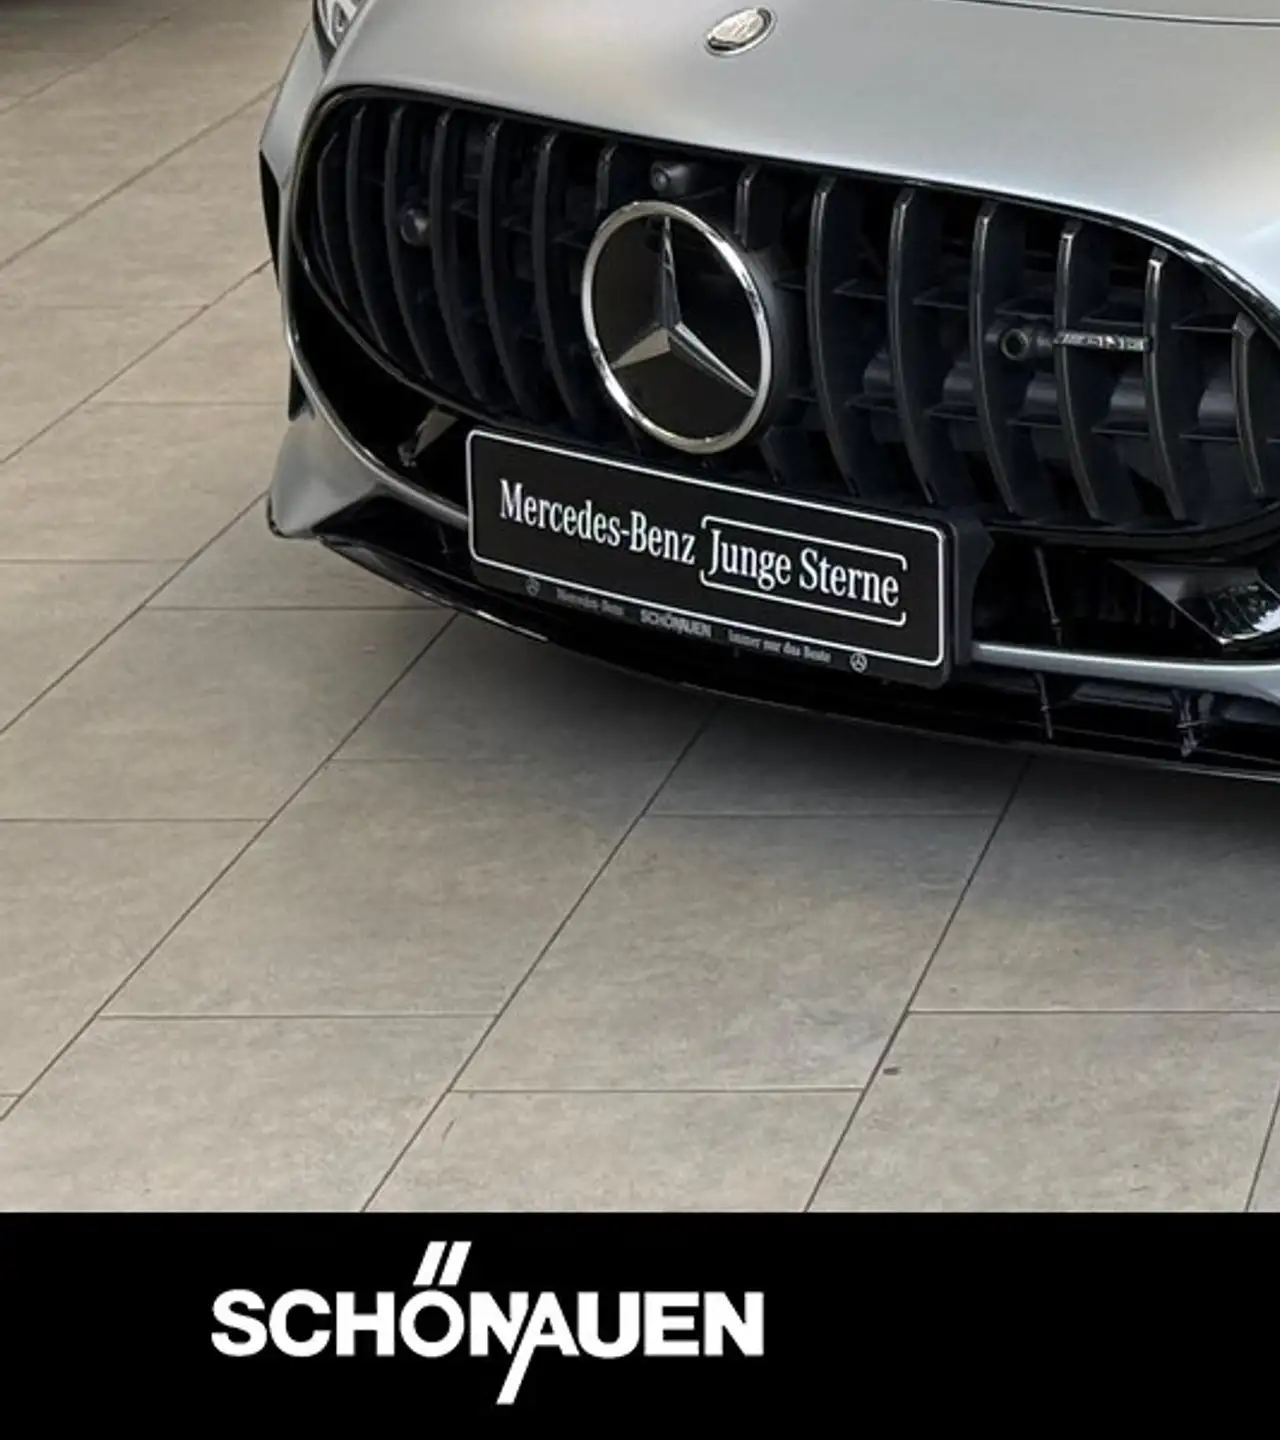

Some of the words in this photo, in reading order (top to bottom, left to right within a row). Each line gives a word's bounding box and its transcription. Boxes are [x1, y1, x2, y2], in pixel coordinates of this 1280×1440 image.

[500, 478, 696, 565] Mercedes-Benz
[708, 529, 792, 591] Junge
[799, 547, 900, 608] Sterne
